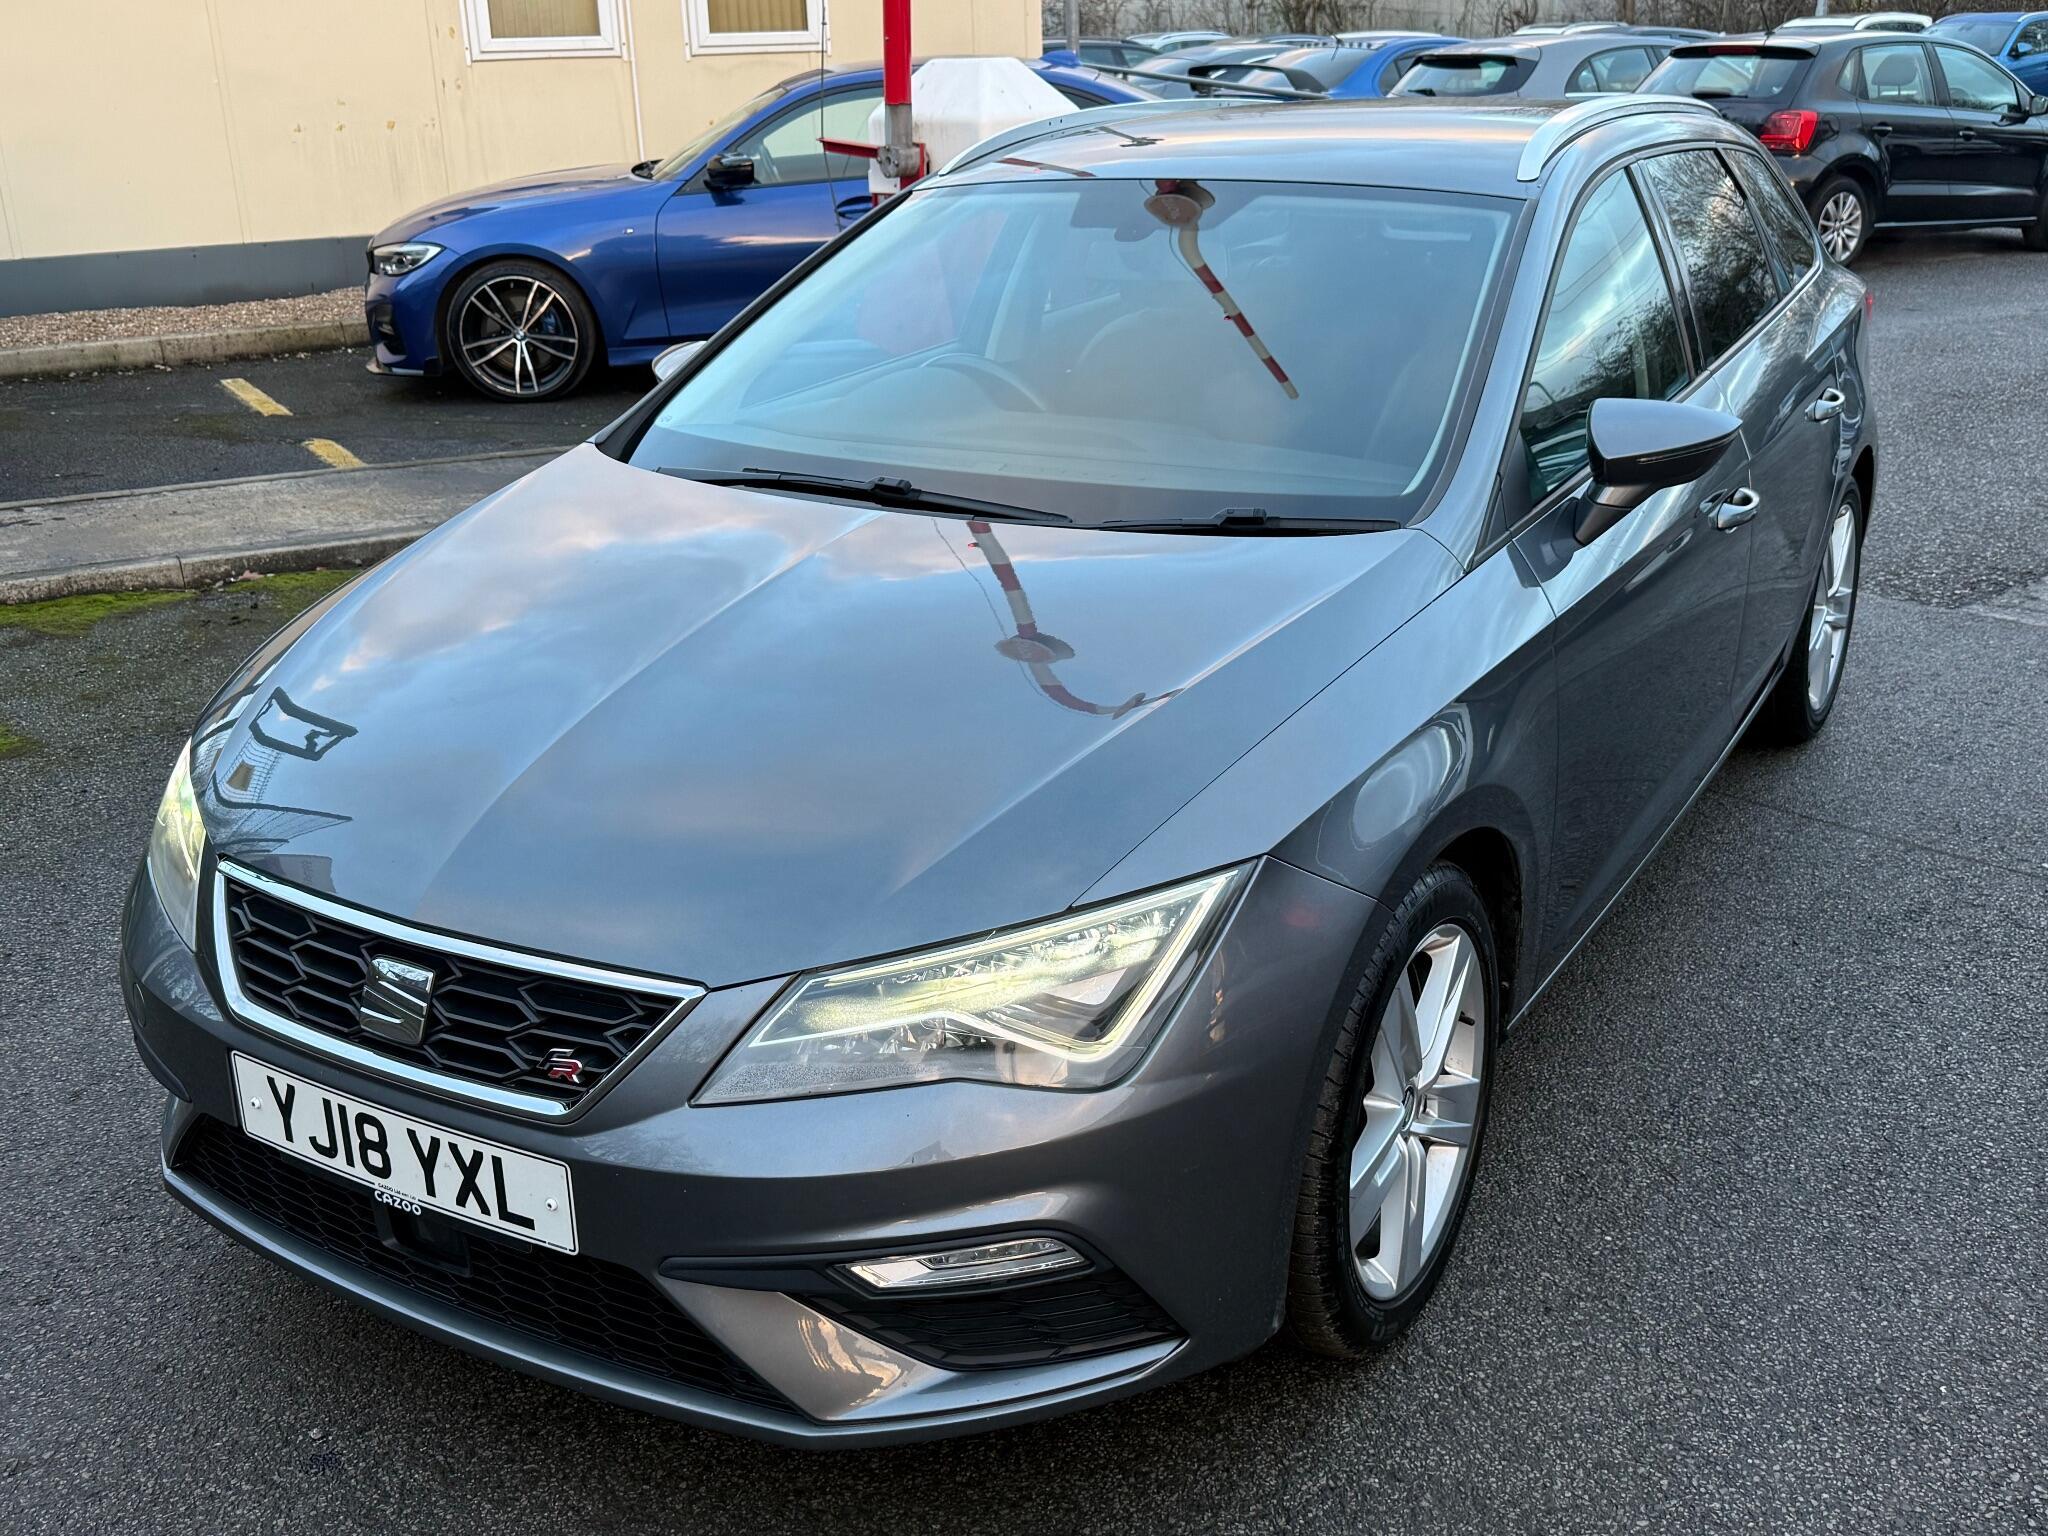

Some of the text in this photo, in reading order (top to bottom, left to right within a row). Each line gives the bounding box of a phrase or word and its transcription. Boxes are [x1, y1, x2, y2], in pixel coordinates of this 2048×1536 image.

[536, 1048, 582, 1084] FR
[266, 1075, 536, 1231] YJ18 YXL
[374, 1190, 422, 1216] CAZOO
